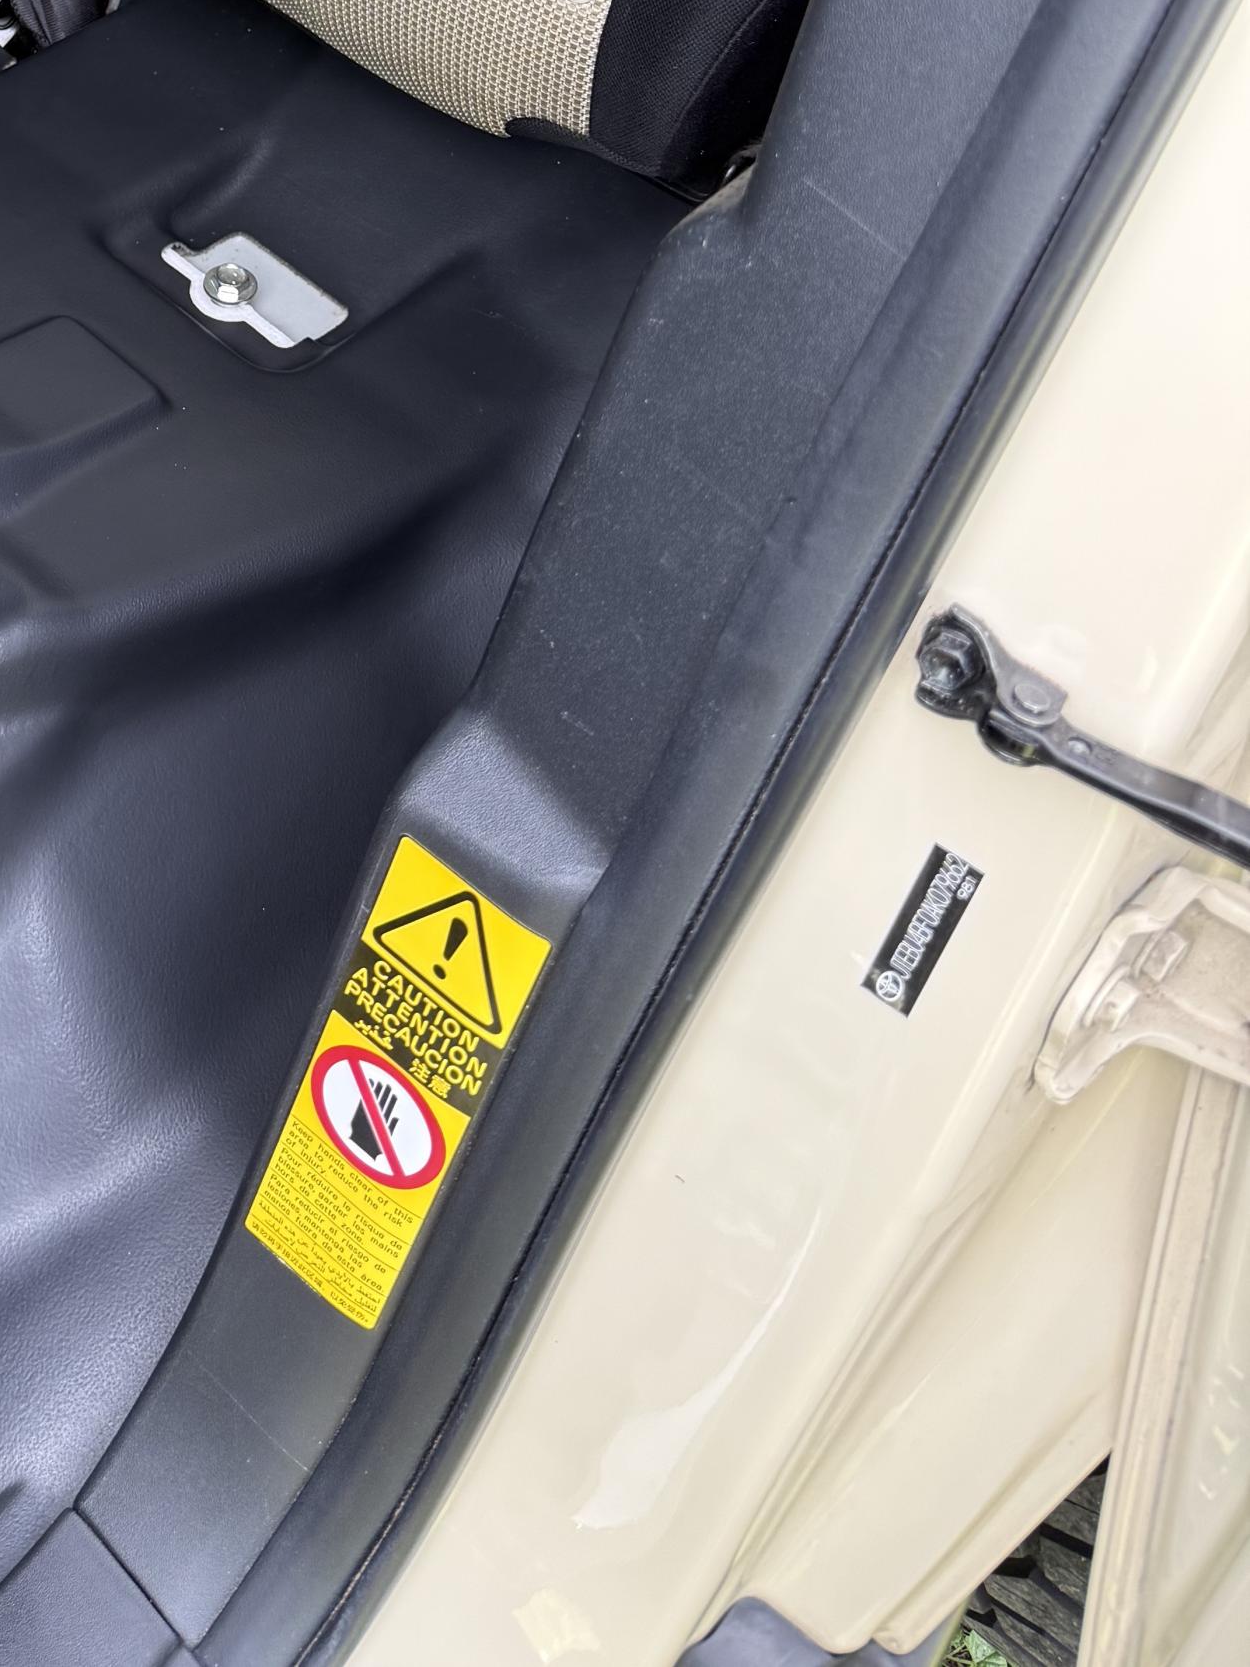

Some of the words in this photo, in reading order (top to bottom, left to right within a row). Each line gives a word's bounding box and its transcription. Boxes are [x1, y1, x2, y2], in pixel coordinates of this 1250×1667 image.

[889, 852, 969, 980] JTEBU4BF0AK079662
[956, 875, 977, 901] 981
[344, 979, 482, 1095] PRECAUCION
[351, 967, 488, 1078] ATTENTION
[373, 960, 480, 1053] CAUTION
[408, 1057, 451, 1098] 注意
[274, 1162, 294, 1183] hors
[299, 1185, 309, 1196] de
[314, 1198, 336, 1220] cette
[340, 1223, 363, 1244] zone.
[280, 1147, 301, 1167] Pour
[306, 1171, 338, 1200] réduire
[342, 1201, 350, 1211] le
[355, 1214, 384, 1239] risque
[389, 1240, 402, 1250] de
[285, 1137, 296, 1147] of
[300, 1148, 326, 1174] injury.
[288, 1130, 308, 1149] area
[314, 1151, 323, 1161] to
[328, 1164, 358, 1192] reduce
[363, 1194, 378, 1209] the
[383, 1211, 402, 1226] risk
[292, 1120, 313, 1142] Keep
[317, 1142, 344, 1170] hands
[349, 1172, 372, 1192] clear
[377, 1196, 388, 1206] of
[394, 1207, 412, 1223] this
[264, 1190, 290, 1215] manos
[295, 1216, 317, 1239] fuera
[321, 1241, 332, 1252] de
[336, 1254, 355, 1272] esta
[270, 1173, 290, 1194] Para
[294, 1196, 324, 1223] reducir
[328, 1226, 337, 1235] el
[341, 1238, 369, 1262] riesgo
[374, 1263, 385, 1273] de
[276, 1155, 315, 1192] blessure,
[318, 1191, 347, 1218] garder
[352, 1220, 364, 1234] les
[370, 1236, 398, 1258] mains
[303, 1215, 344, 1253] mantenga
[349, 1253, 361, 1268] las
